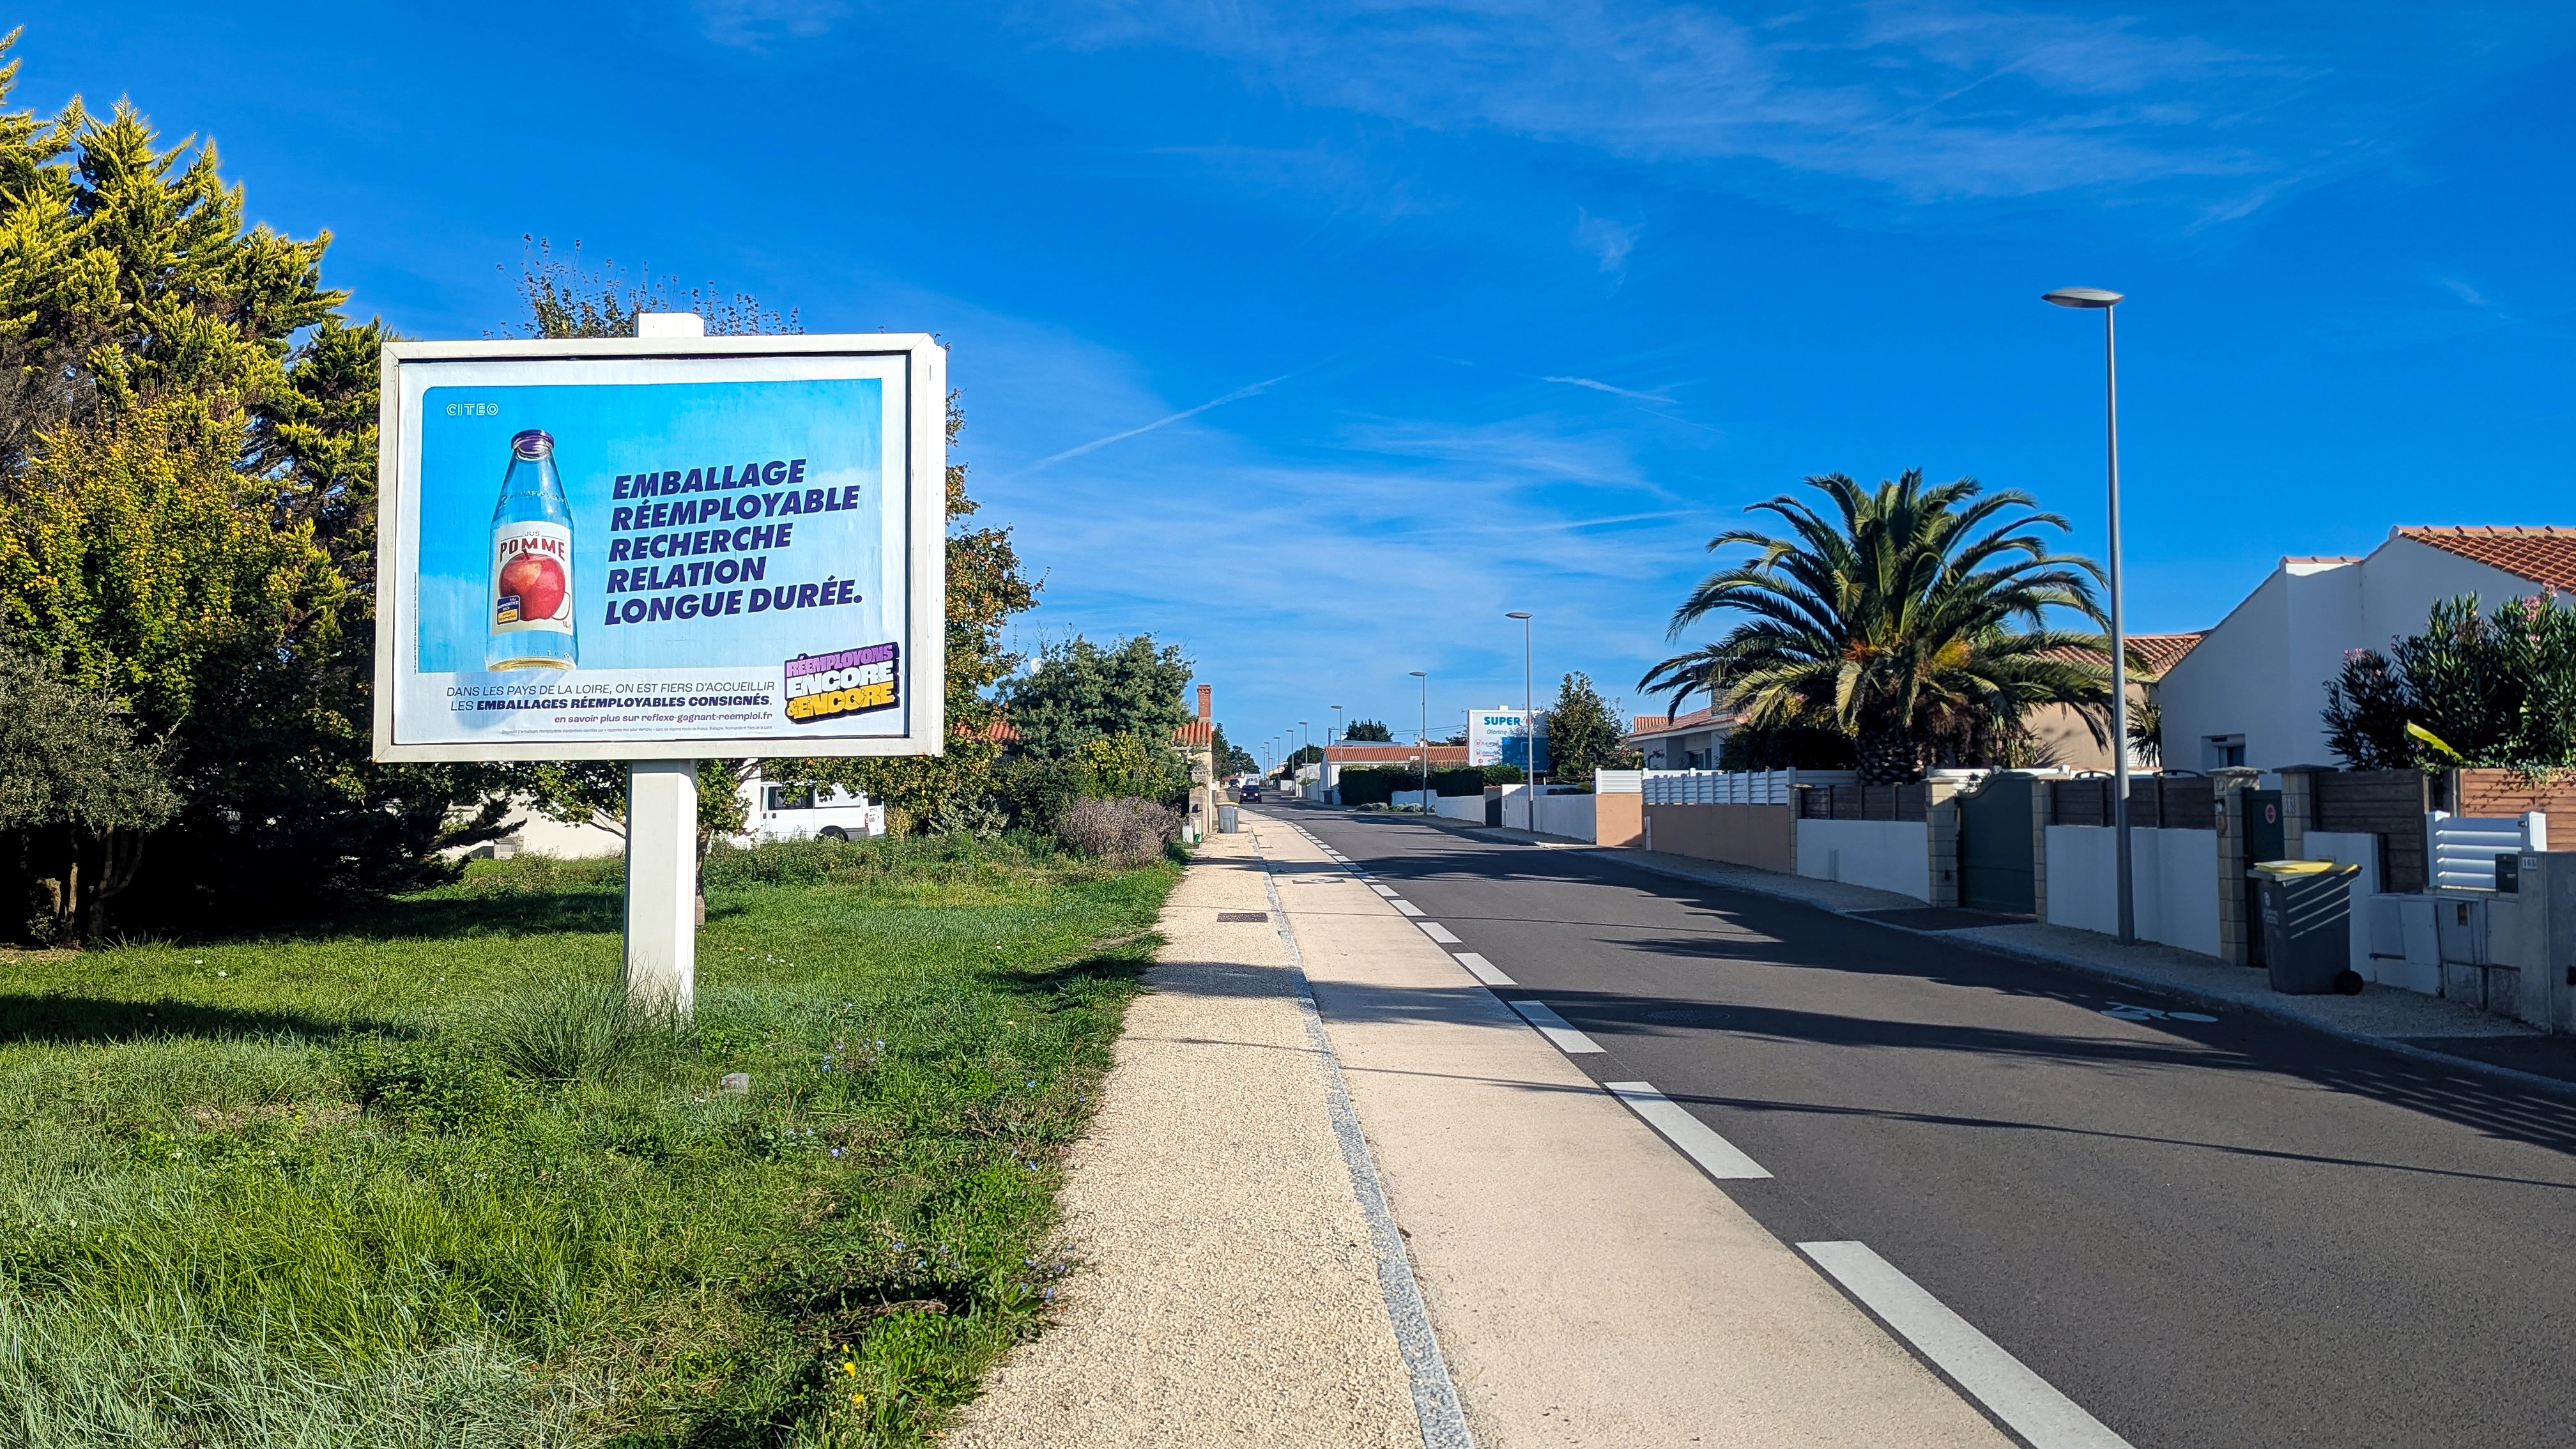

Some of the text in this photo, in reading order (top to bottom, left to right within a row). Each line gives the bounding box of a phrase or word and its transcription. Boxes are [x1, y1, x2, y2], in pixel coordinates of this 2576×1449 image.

[447, 403, 499, 416] CITEO
[612, 459, 806, 500] EMBALLAGE
[610, 485, 860, 532] RÉEMPLOYABLE
[500, 538, 565, 563] POMME
[608, 523, 793, 562] RECHERCHE
[606, 556, 767, 594] RELATION
[604, 575, 862, 625] LONGUE DURÉE.
[786, 645, 893, 677] RÉEMPLOYONS
[447, 682, 775, 696] DANS LES PAYS DE LA LOIRE, ON EST FIERS D'ACCUEILLIR
[786, 660, 894, 698] ENCORE
[450, 693, 772, 710] LES EMBALLAGES RÉEMPLOYABLES CONSIGNÉS.
[568, 715, 599, 723] savoir
[601, 714, 620, 723] plus
[641, 712, 772, 723] reflexe-gagnant-reemploi.fr
[1483, 716, 1521, 726] SUPER
